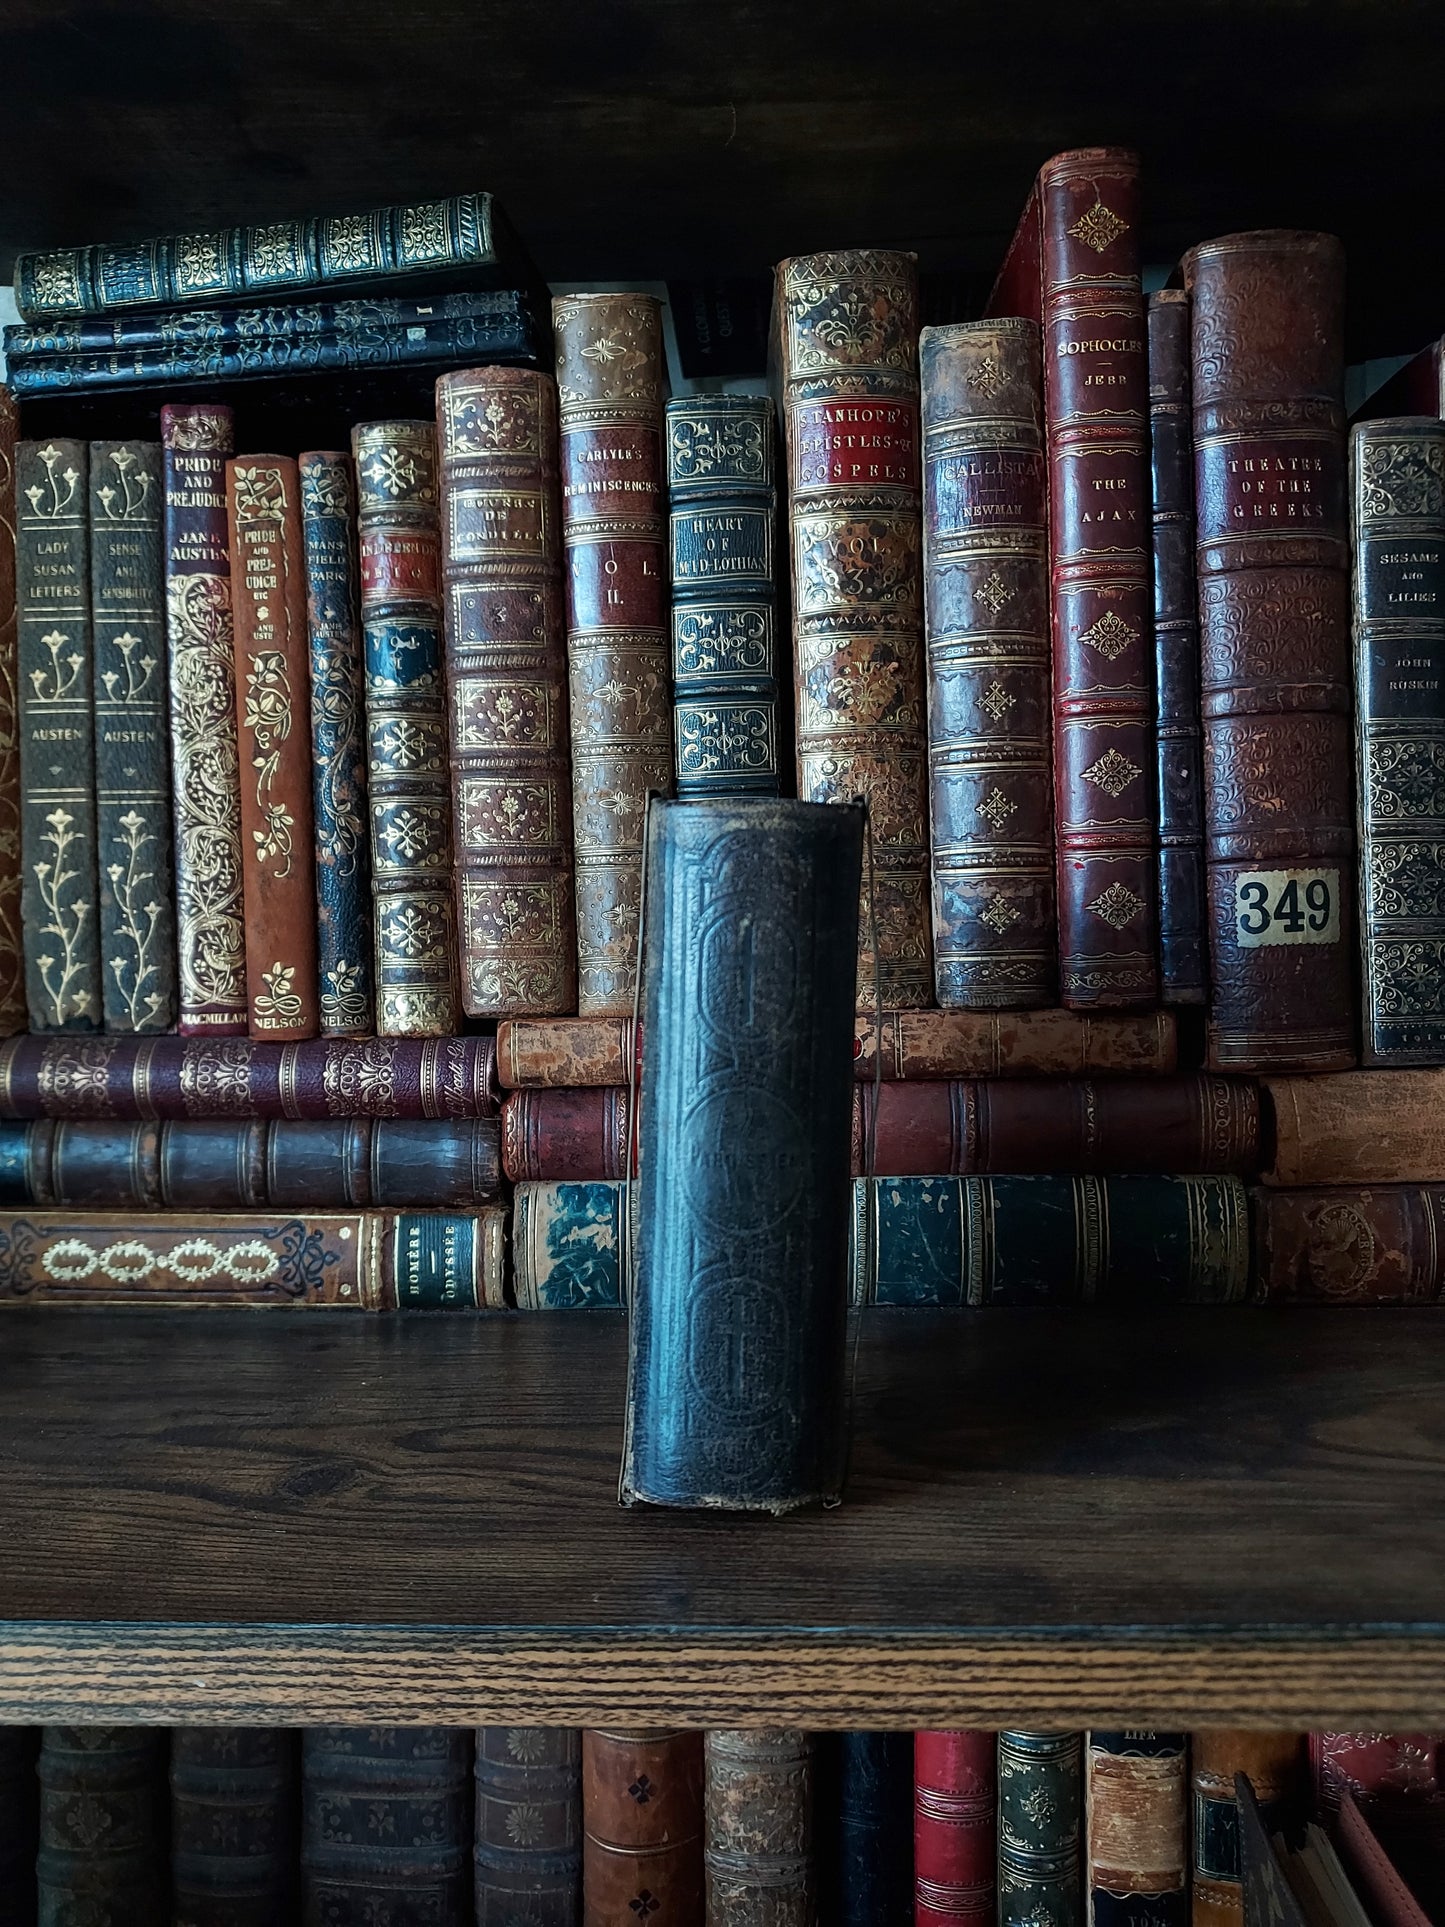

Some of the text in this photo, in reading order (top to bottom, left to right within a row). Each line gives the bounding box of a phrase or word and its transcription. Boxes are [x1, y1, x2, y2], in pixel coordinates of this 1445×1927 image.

[716, 302, 733, 337] QUEST
[1058, 339, 1144, 357] SOPHOCLES
[1084, 375, 1127, 386] JEBB
[799, 408, 910, 429] STANHOPE'S
[578, 444, 642, 462] CARLYLE'S
[802, 462, 907, 482] GOSPELS
[944, 461, 1037, 481] CALLISTA
[1228, 458, 1323, 473] THEATRE
[184, 475, 213, 488] AND
[1092, 479, 1127, 490] THE
[1241, 480, 1311, 494] OF THE
[962, 504, 1023, 518] NEWMAN
[1081, 510, 1136, 523] AJAX
[1233, 503, 1324, 518] GREEKS
[692, 517, 743, 534] HEART
[244, 530, 276, 543] PRIDE
[37, 542, 70, 555] LADY
[108, 543, 142, 556] SENSE
[252, 546, 269, 555] AND
[706, 537, 729, 551] OF
[308, 555, 345, 565] FIELD
[1380, 553, 1440, 565] SESAME
[32, 564, 76, 577] SUSAN
[115, 566, 138, 578] AND
[679, 557, 766, 575] MID-LOTHIAN
[245, 575, 277, 589] UDICE
[310, 571, 346, 580] PARK
[1401, 571, 1424, 581] AND
[29, 585, 81, 598] LETTERS
[101, 587, 154, 599] SENSIBILITY
[1388, 593, 1437, 603] LILIES
[1395, 658, 1432, 668] JOHN
[1389, 680, 1439, 691] RUSKIN
[31, 728, 82, 741] AUSTEN
[104, 730, 155, 743] AUSTEN
[1240, 879, 1330, 935] 349
[181, 1013, 247, 1026] MACMILLAN
[254, 1016, 308, 1030] NELSON
[321, 1015, 370, 1028] NELSON
[407, 1226, 420, 1295] HOMÈRE
[442, 1226, 456, 1299] ODYSSÉE
